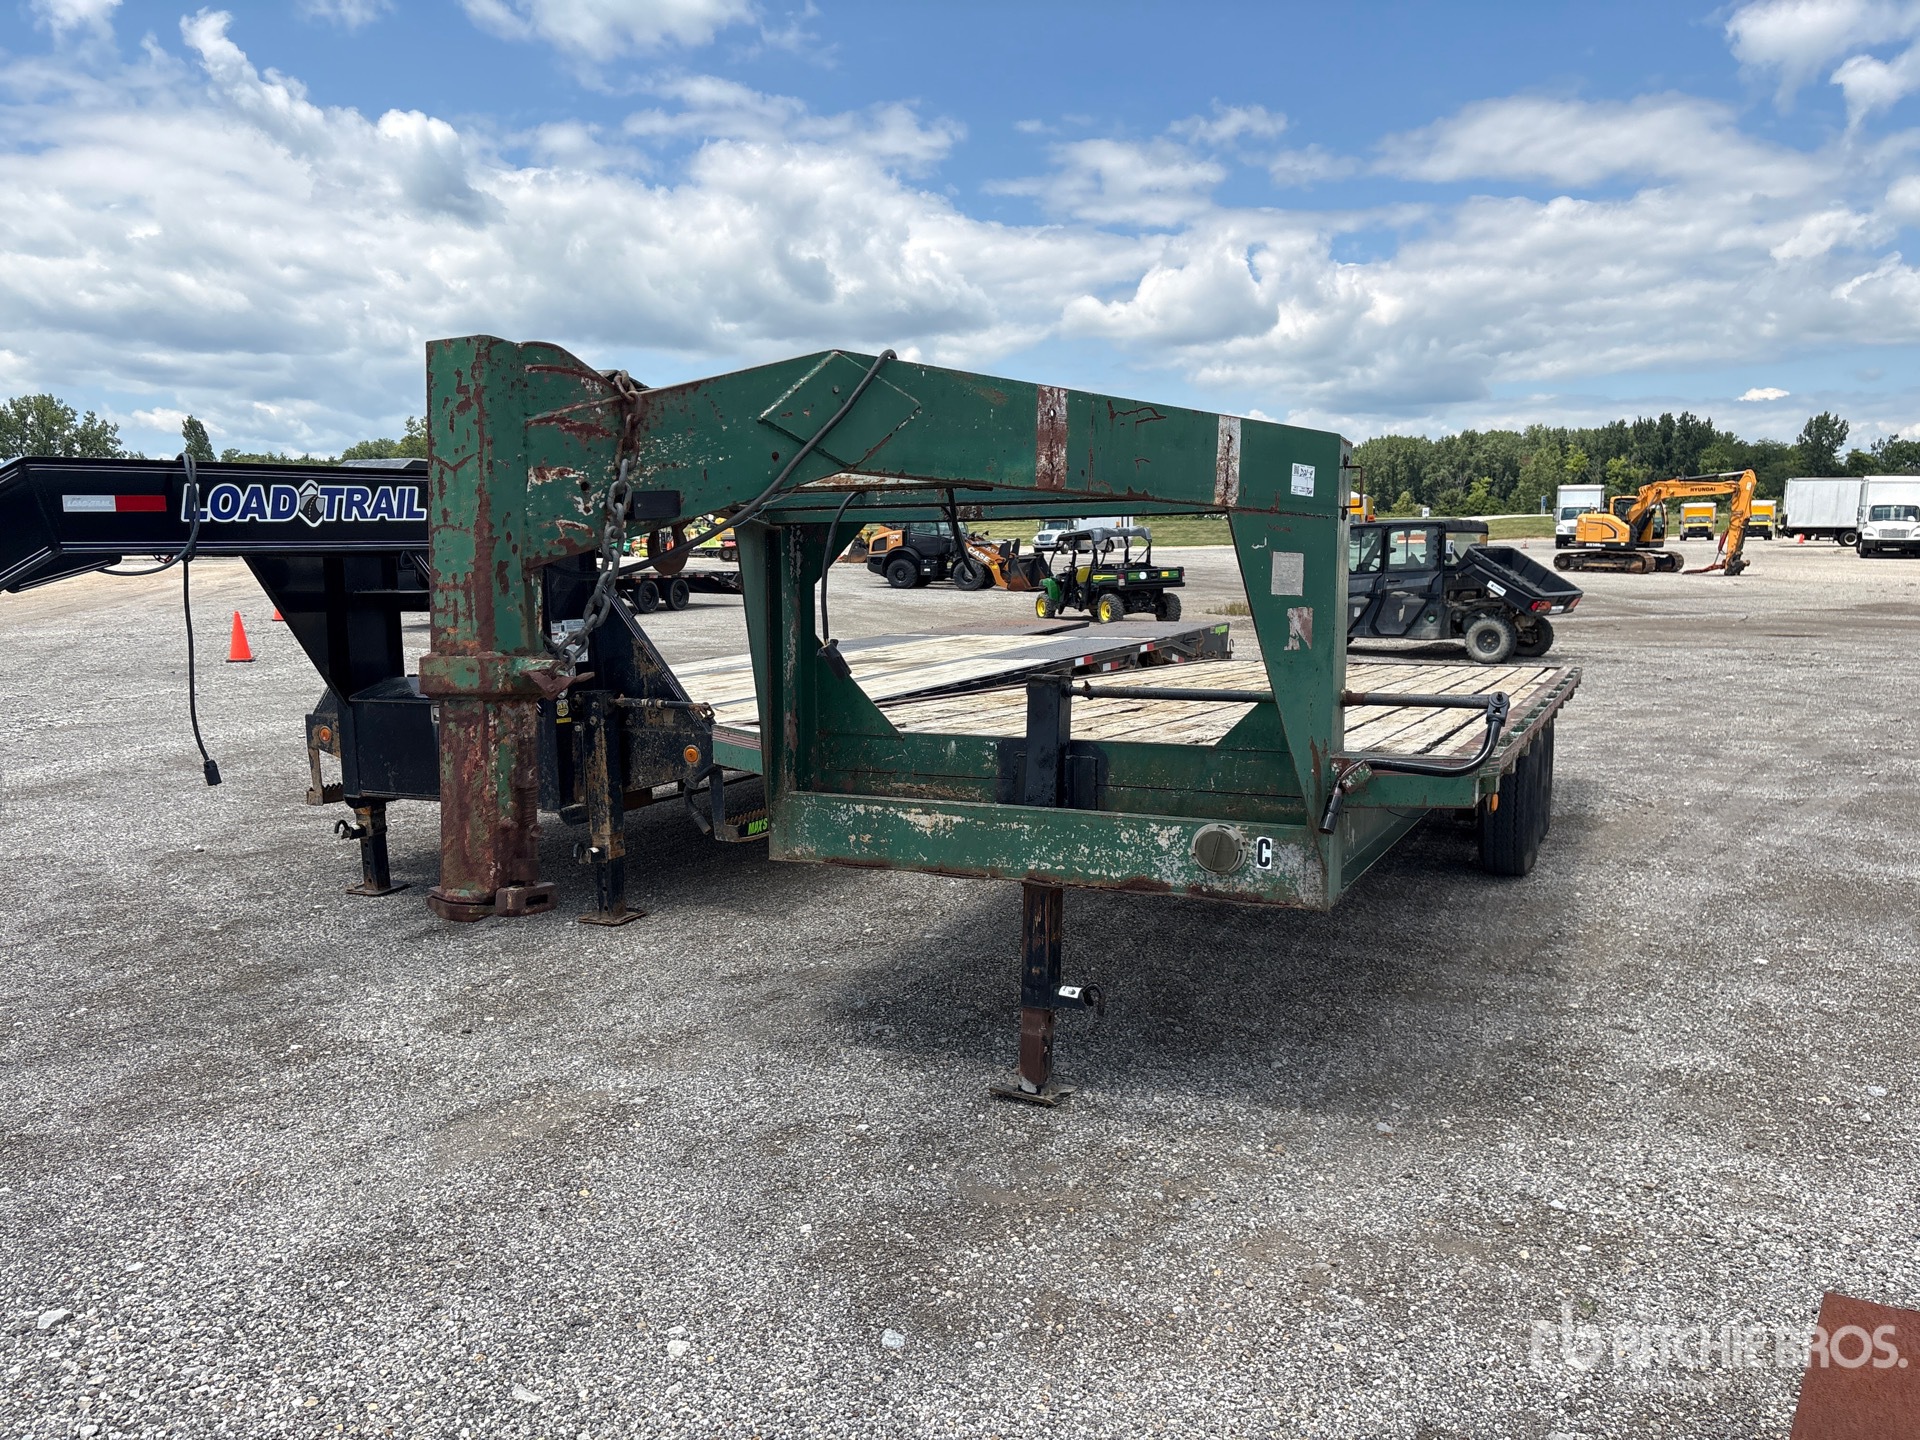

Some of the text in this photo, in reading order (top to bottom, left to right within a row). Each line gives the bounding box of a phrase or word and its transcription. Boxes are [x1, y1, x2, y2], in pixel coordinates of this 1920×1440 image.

[181, 483, 427, 522] LOAD TRAIL
[967, 546, 991, 563] CASE
[1257, 838, 1271, 868] C
